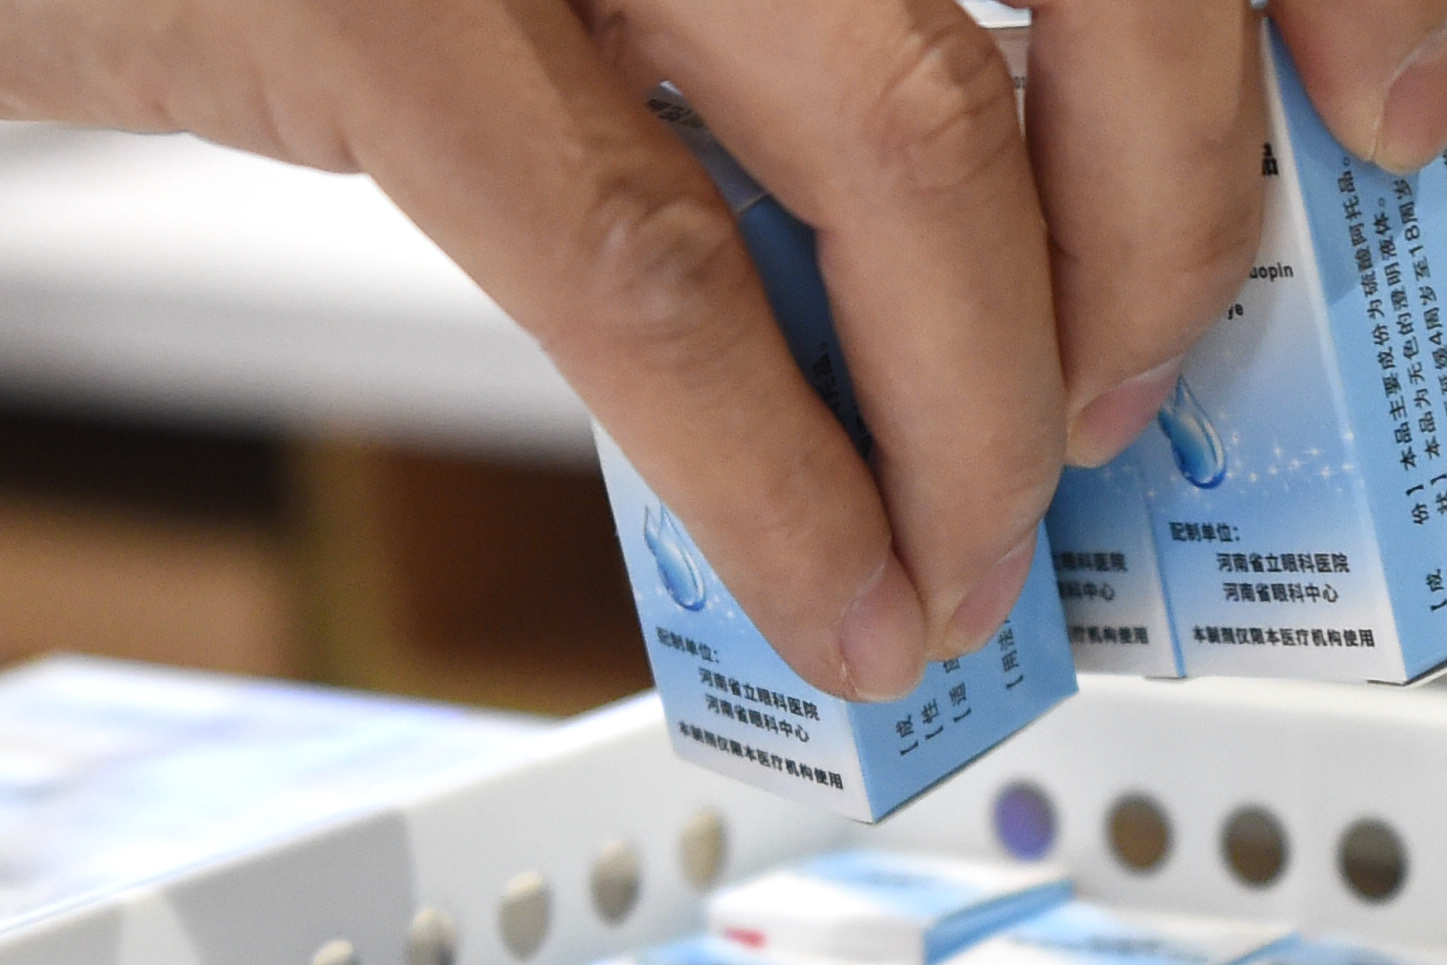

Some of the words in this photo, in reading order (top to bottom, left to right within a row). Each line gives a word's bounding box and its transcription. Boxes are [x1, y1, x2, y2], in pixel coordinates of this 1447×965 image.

[1216, 552, 1350, 573] 河南省立眼科医院
[1222, 582, 1339, 603] 河南省眼科中心
[1192, 625, 1376, 649] 本制剂仅限本医疗机构使用
[698, 667, 821, 722] 河南省立眼科医院
[705, 693, 810, 743] 河南省眼科中心
